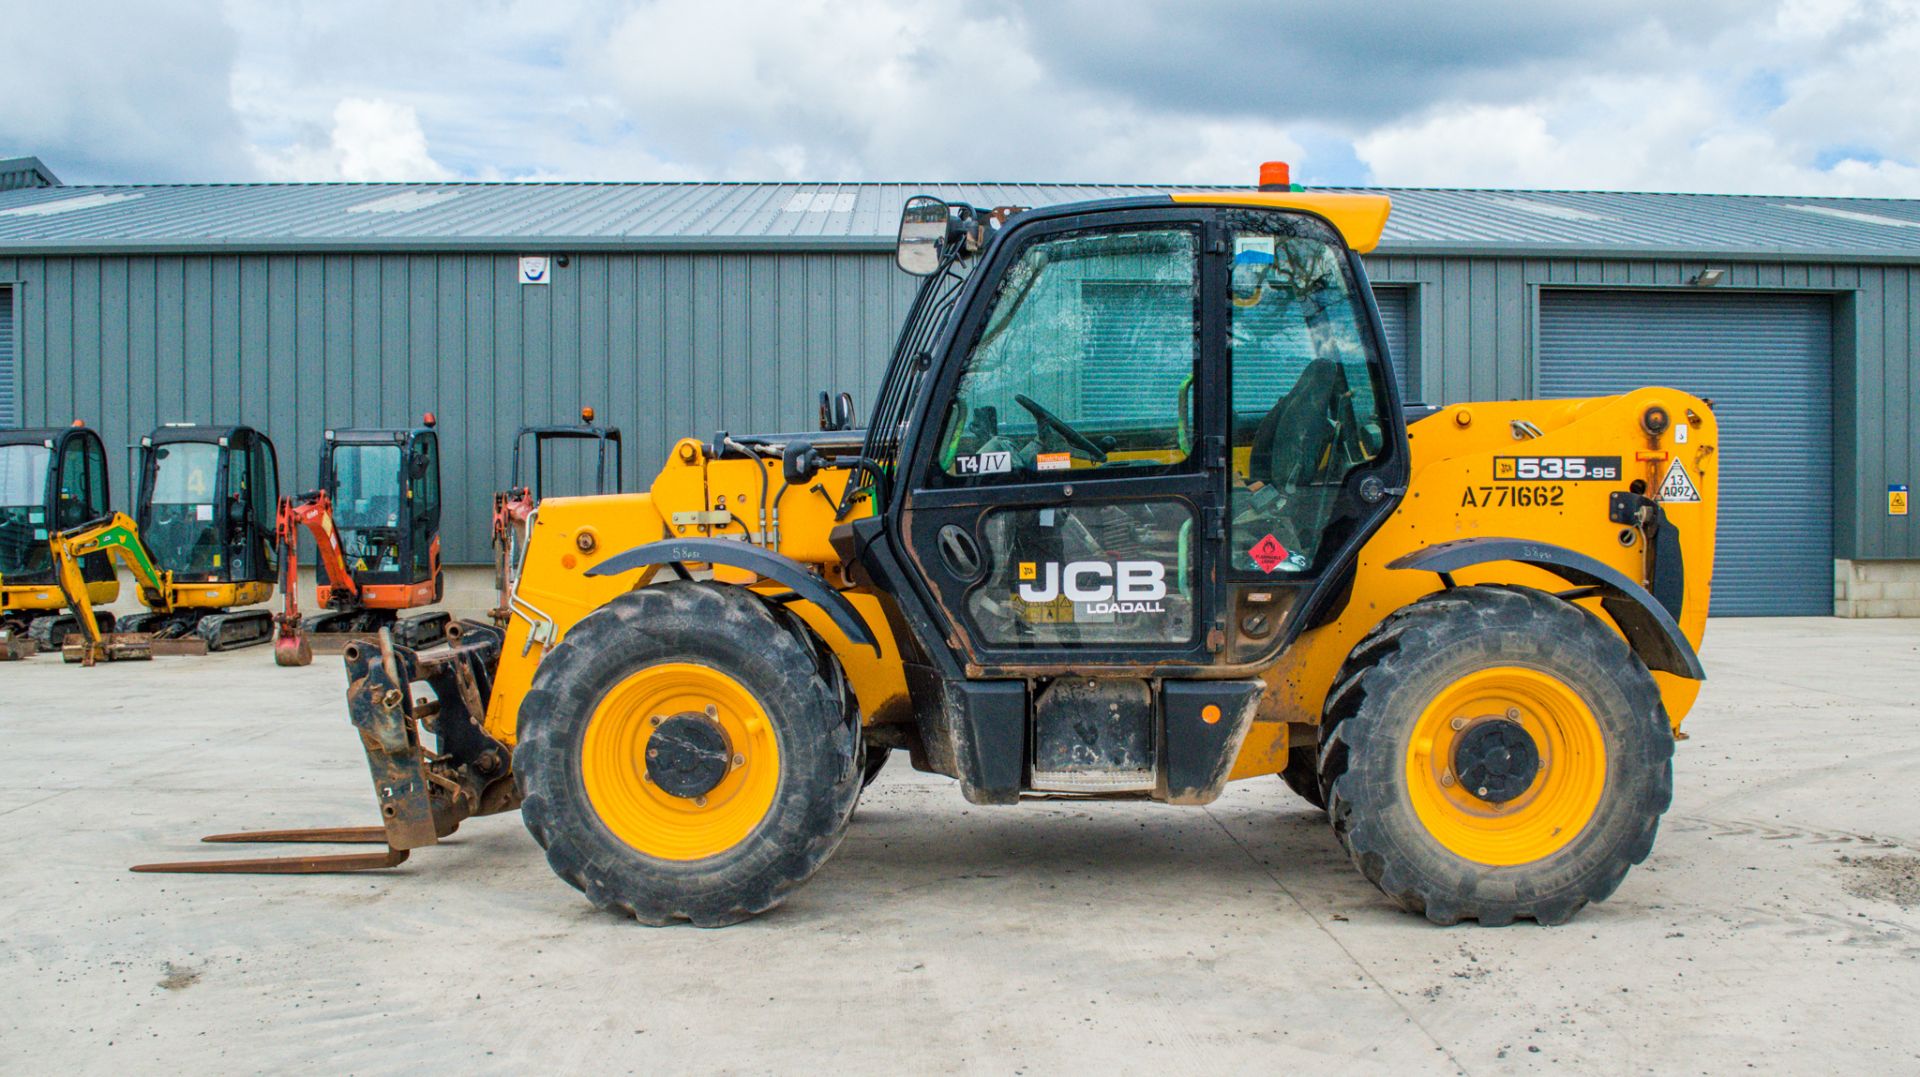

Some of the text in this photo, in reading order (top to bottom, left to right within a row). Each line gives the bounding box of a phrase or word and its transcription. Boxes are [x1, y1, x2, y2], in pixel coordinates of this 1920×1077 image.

[957, 454, 1006, 473] T4 IV
[1517, 458, 1616, 478] 535-95
[1670, 475, 1684, 486] 13
[1461, 486, 1564, 507] A771662
[1019, 561, 1167, 602] JCB
[1086, 602, 1165, 614] LOADALL
